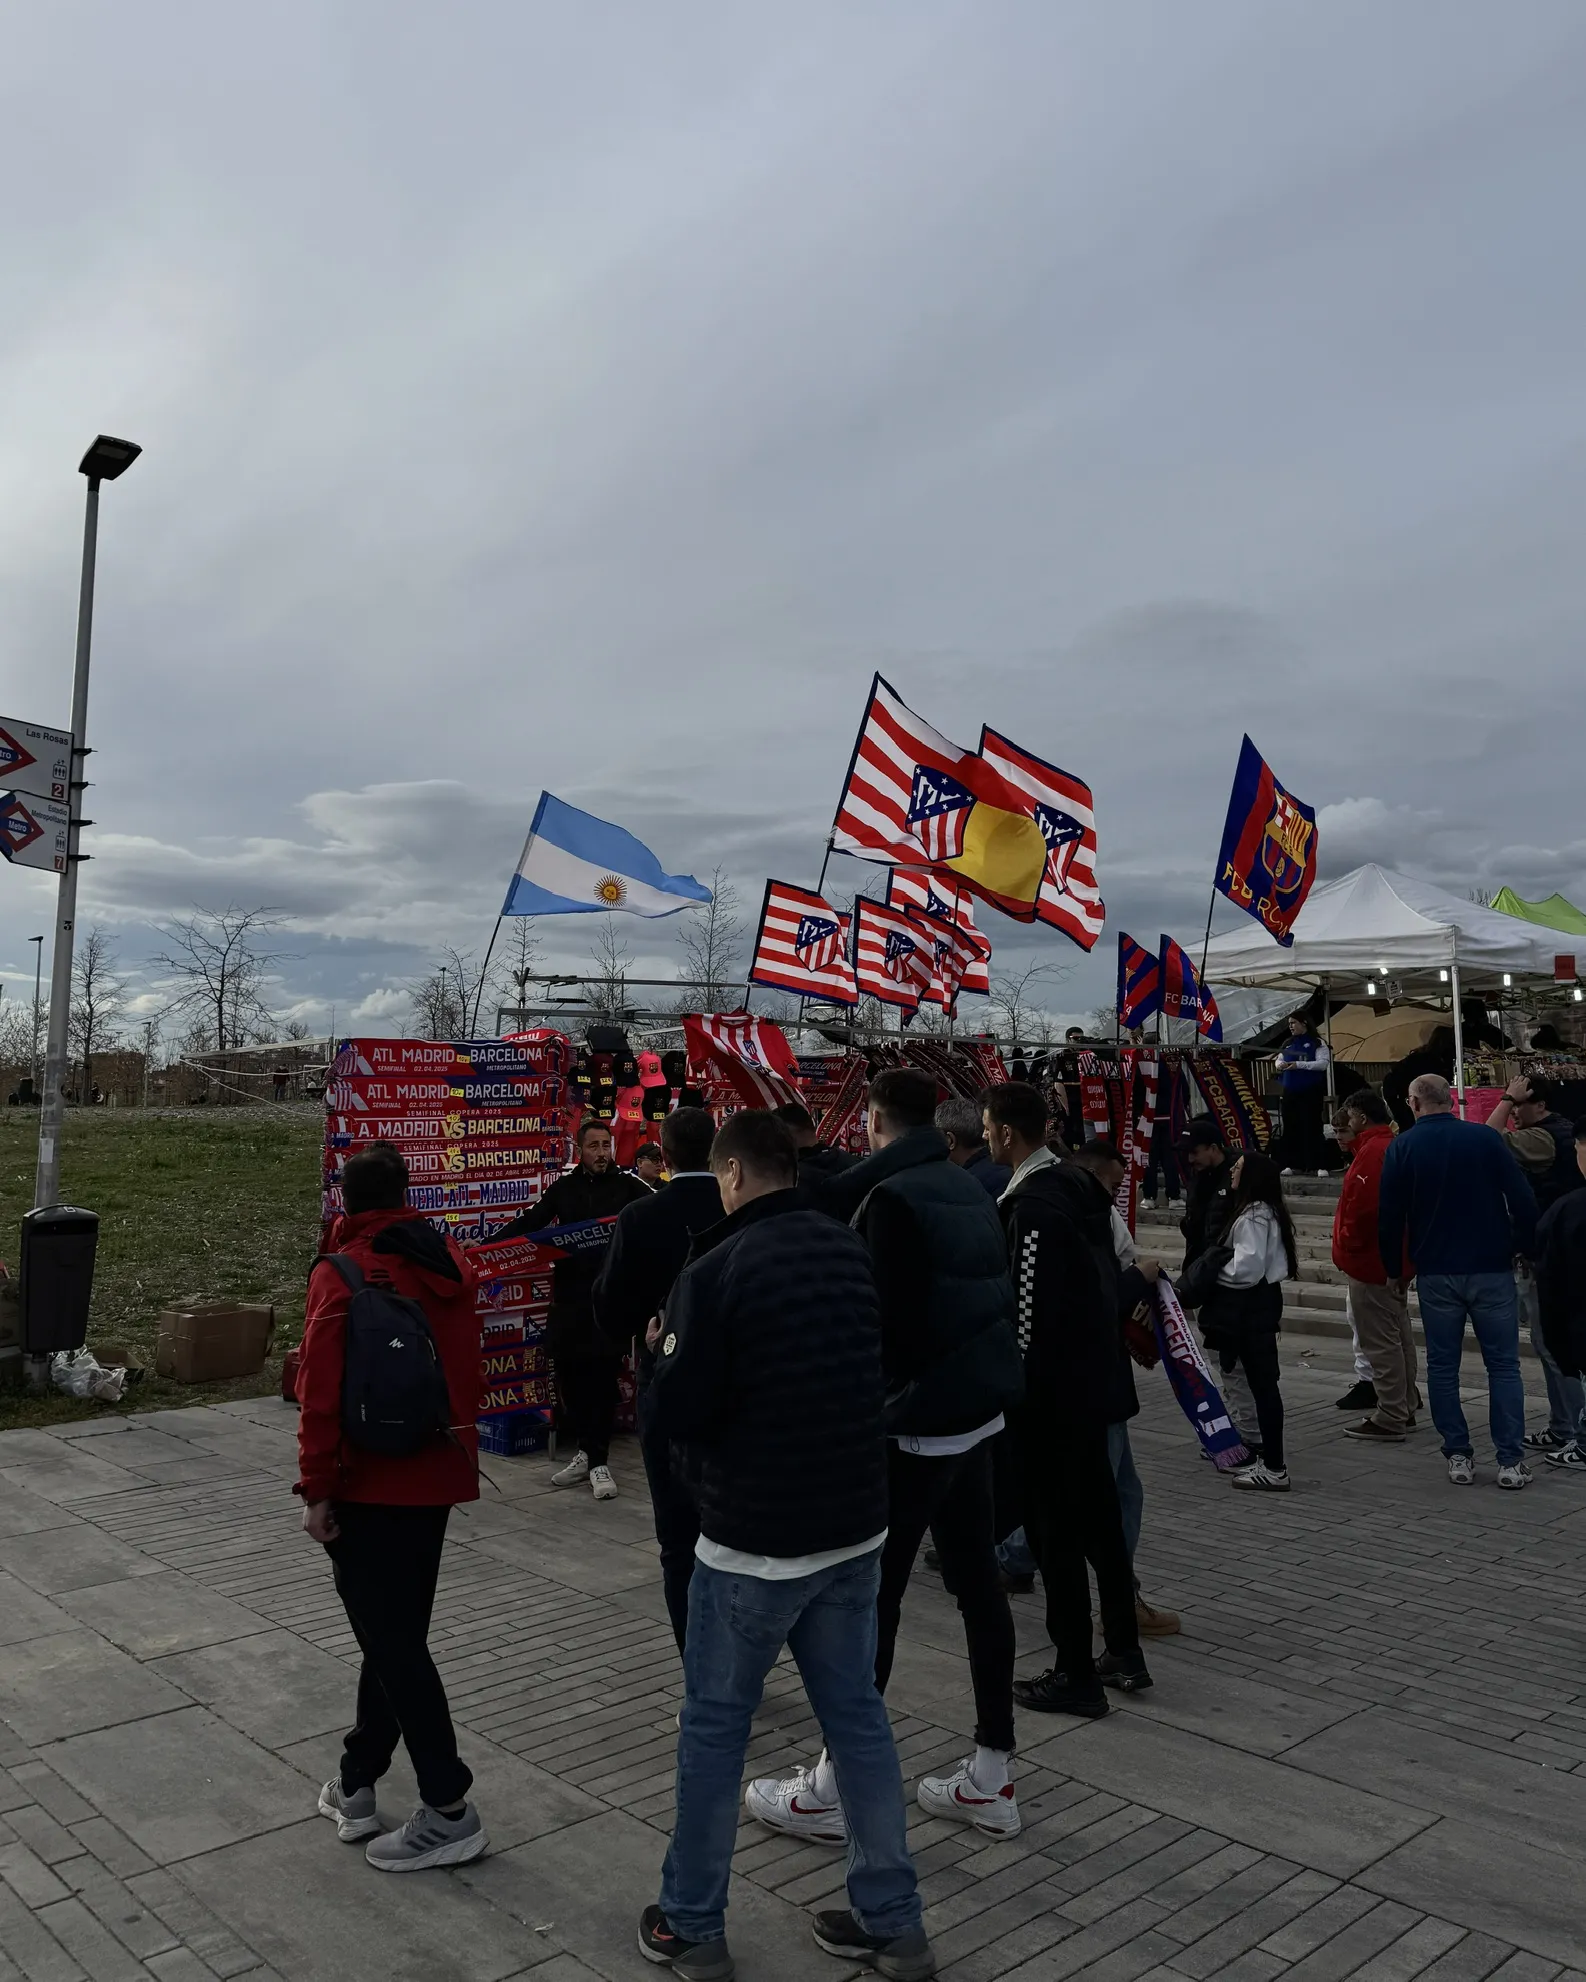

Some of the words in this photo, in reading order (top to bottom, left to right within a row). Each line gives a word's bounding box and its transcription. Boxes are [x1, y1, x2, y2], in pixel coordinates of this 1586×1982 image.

[26, 728, 41, 739] Las
[43, 733, 69, 746] Rosas
[53, 784, 62, 797] 2
[31, 809, 67, 826] Metropolitano
[48, 804, 68, 816] Estadio
[8, 820, 27, 832] Metro
[56, 856, 63, 869] 7
[1165, 992, 1179, 1004] FC
[372, 1047, 397, 1062] ATL
[402, 1048, 455, 1063] MADRID
[470, 1047, 543, 1063] BARCELONA
[366, 1083, 392, 1099] ATL
[396, 1084, 450, 1099] MADRID
[465, 1083, 540, 1099] BARCELONA
[1220, 1058, 1256, 1111] LAMINE
[358, 1122, 374, 1138] A.
[378, 1120, 440, 1138] MADRID
[440, 1120, 466, 1140] VS
[468, 1117, 541, 1135] BARCELONA
[482, 1140, 499, 1148] 2025
[404, 1154, 439, 1171] DRID
[440, 1154, 466, 1173] VS
[467, 1149, 541, 1168] BARCELONA
[441, 1172, 464, 1180] MADRID
[480, 1180, 529, 1205] MADRID
[1114, 1176, 1131, 1224] MADRI
[552, 1222, 616, 1246] BARCELO
[478, 1242, 539, 1265] MADRID
[499, 1254, 537, 1271] 02.04.2025
